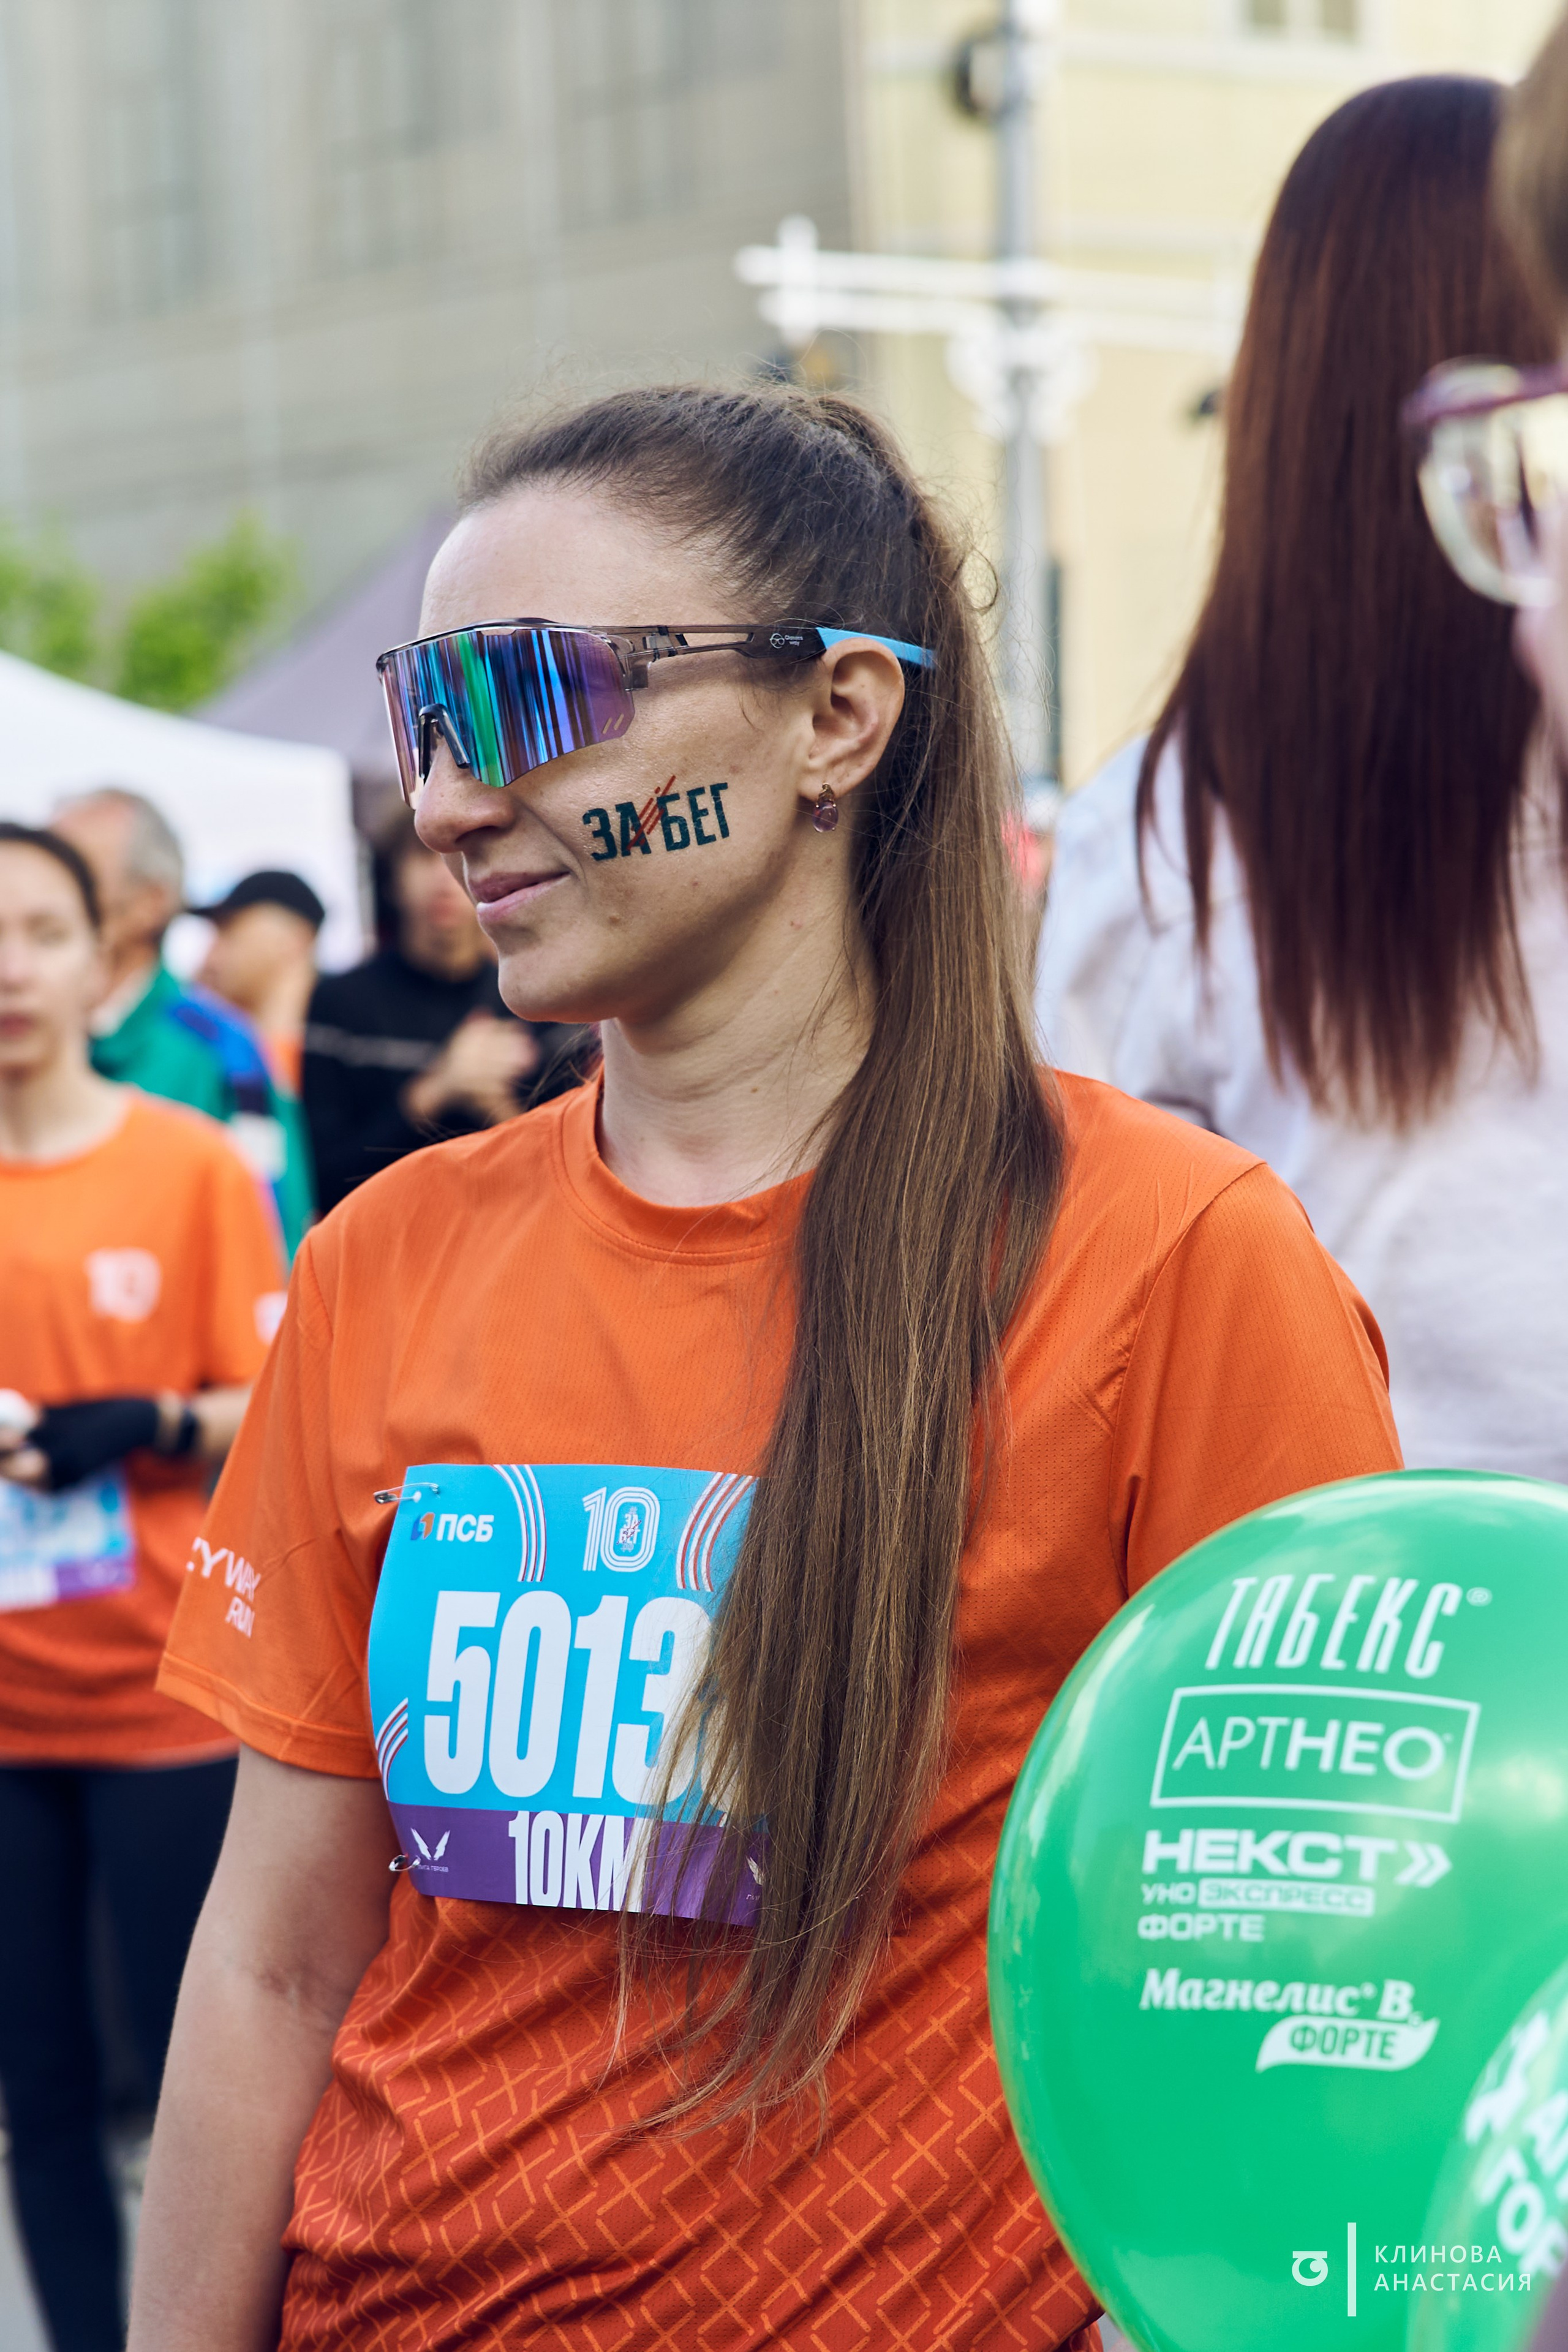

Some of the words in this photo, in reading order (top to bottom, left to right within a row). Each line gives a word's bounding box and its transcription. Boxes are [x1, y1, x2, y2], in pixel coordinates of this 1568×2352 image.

[435, 1513, 494, 1542] ПСБ
[582, 1487, 660, 1573] 10
[225, 1596, 255, 1638] RUN
[423, 1591, 738, 1812] 5013
[1142, 1828, 1398, 1882] НЕКСТ
[1204, 1883, 1370, 1910] ЭКСПРЕСС
[1137, 1913, 1265, 1942] ФОРТЕ
[1289, 2024, 1398, 2061] ФОРТЕ
